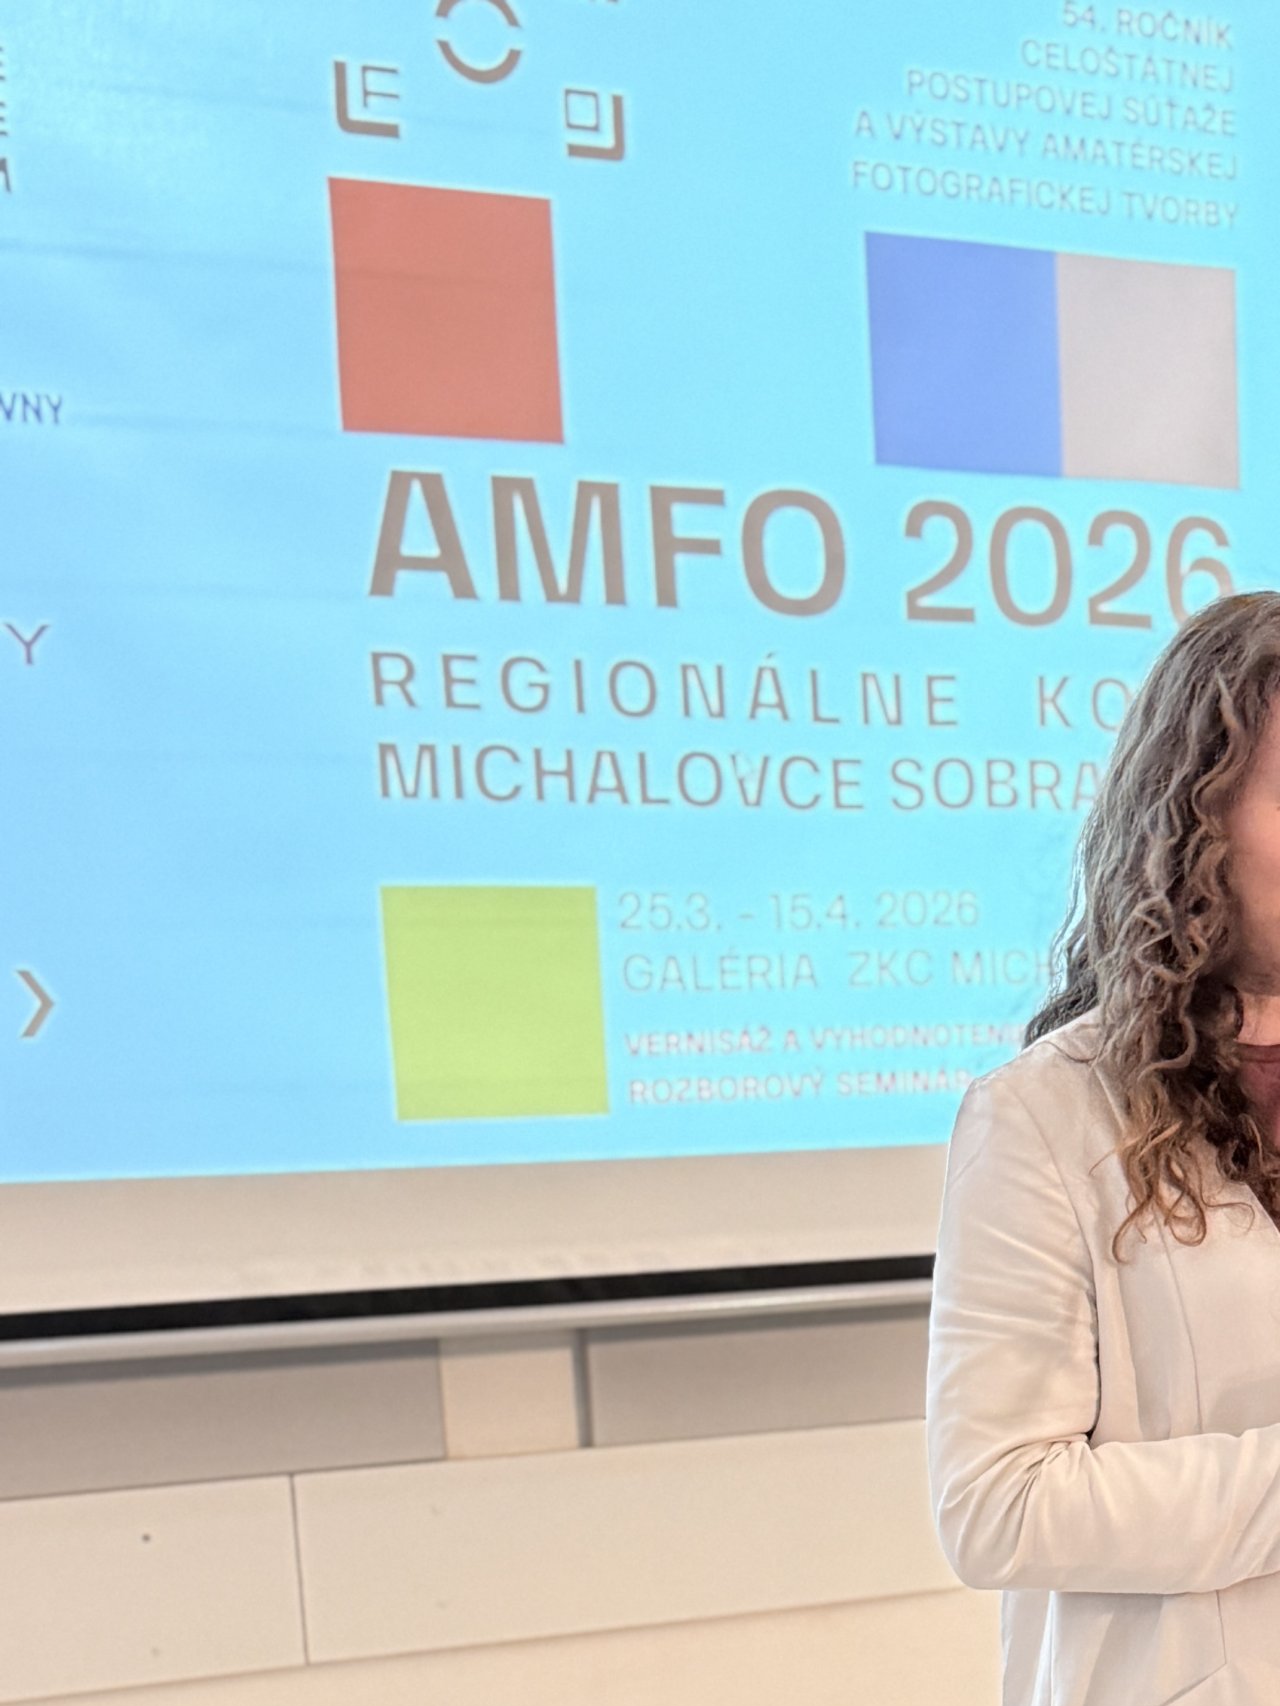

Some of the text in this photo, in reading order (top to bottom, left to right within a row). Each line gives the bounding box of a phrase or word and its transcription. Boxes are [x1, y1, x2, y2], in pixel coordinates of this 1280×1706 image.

[1117, 8, 1233, 50] ROČNÍK
[907, 69, 1113, 122] POSTUPOVEJ
[855, 109, 1239, 181] A VÝSTAVY AMATÉRSKEJ
[852, 160, 1239, 230] FOTOGRAFICKEJ TVORBY
[368, 469, 1234, 630] AMFO 2026
[370, 650, 960, 728] REGIONÁLNE
[378, 742, 1103, 812] MICHALOVCE SOBRA
[619, 891, 723, 932] 25.3.
[770, 891, 862, 932] 15.4.
[875, 890, 981, 930] 2026
[622, 945, 819, 993] GALÉRIA
[848, 949, 935, 989] ZKC
[782, 1028, 801, 1052] A
[628, 1066, 824, 1105] ROZBOROVÝ
